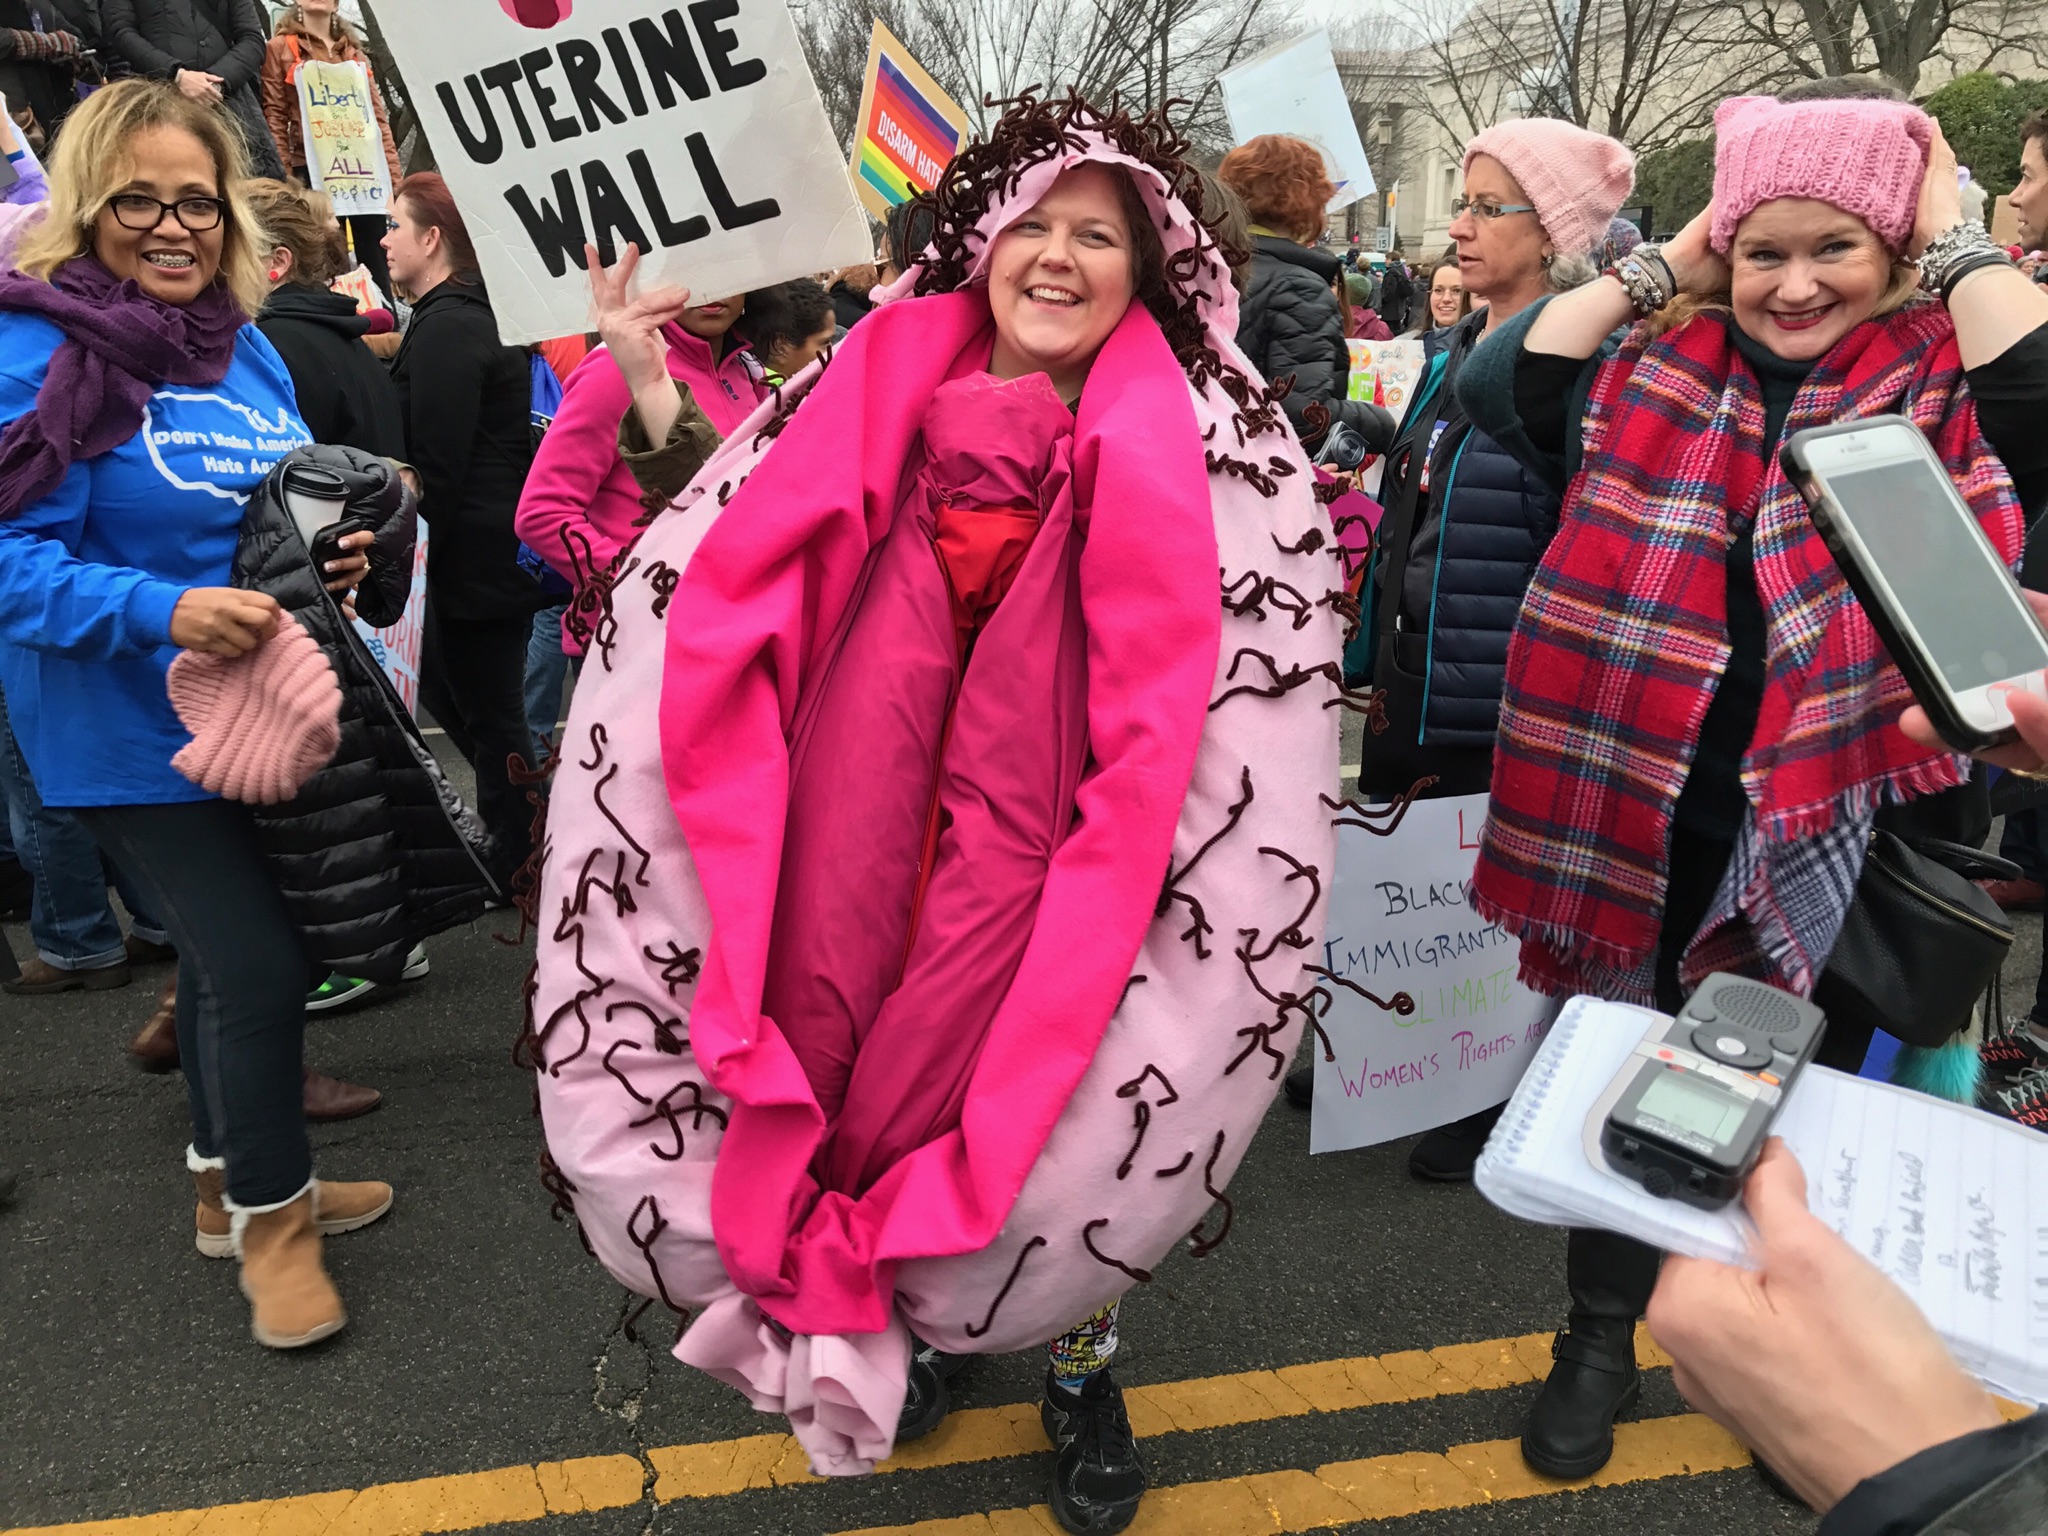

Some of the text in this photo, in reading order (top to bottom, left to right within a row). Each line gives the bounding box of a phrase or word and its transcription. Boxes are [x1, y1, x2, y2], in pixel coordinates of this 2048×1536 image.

[435, 0, 767, 164] UTERINE
[329, 156, 374, 175] ALL
[877, 109, 918, 168] DISARM
[503, 131, 782, 278] WALL
[202, 455, 245, 474] Hate
[1318, 922, 1508, 982] IMMIGRANTS
